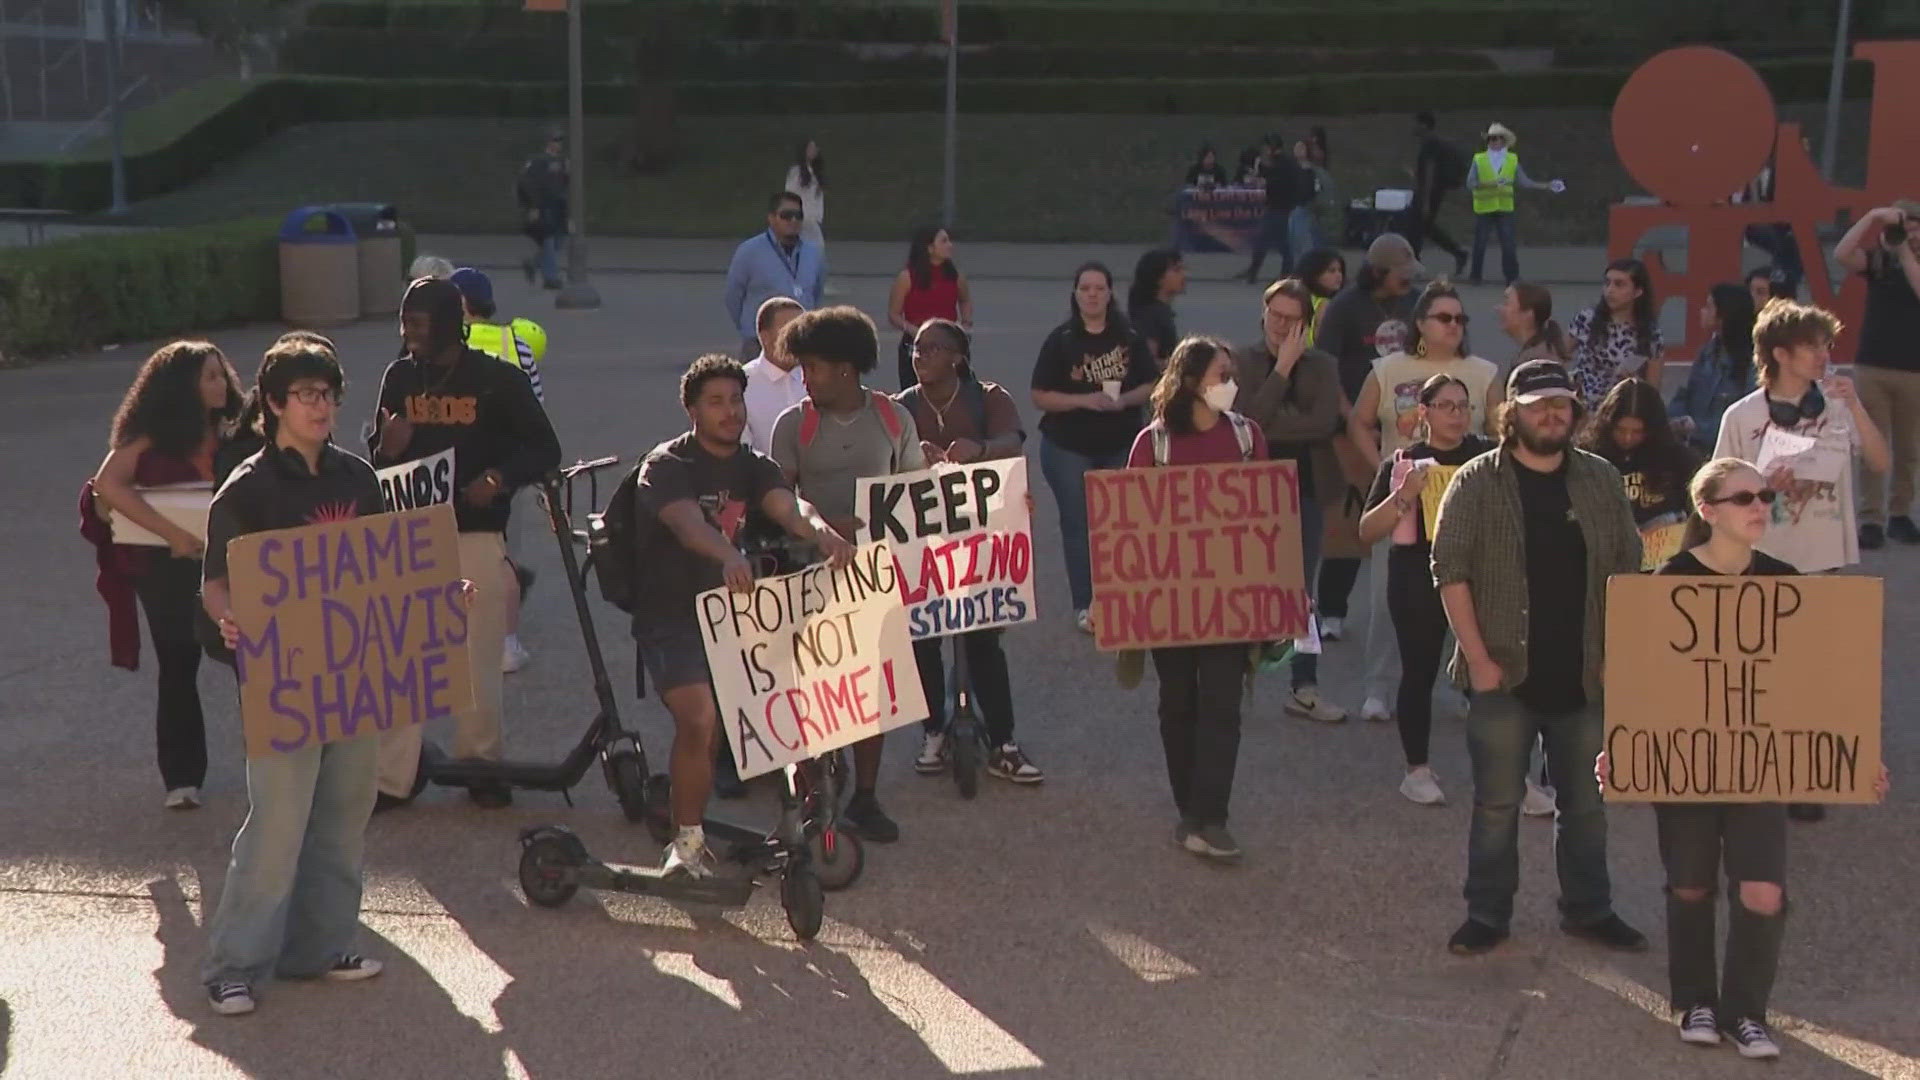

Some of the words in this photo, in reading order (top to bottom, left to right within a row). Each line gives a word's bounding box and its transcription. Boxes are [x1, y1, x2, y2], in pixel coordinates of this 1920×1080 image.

[869, 468, 1000, 544] KEEP
[1085, 465, 1299, 531] DIVERSITY
[259, 517, 435, 606] SHAME
[892, 531, 1030, 606] LATINO
[1090, 523, 1281, 584] EQUITY
[321, 580, 468, 674] DAVIS
[703, 545, 896, 643] PROTESTING
[909, 587, 1027, 637] STUDIES
[1096, 584, 1309, 647] INCLUSION
[1669, 581, 1801, 654] STOP
[741, 642, 776, 696] IS
[792, 609, 861, 676] NOT
[269, 653, 451, 753] SHAME
[1691, 657, 1771, 727] THE
[738, 707, 774, 770] A
[1607, 724, 1859, 796] CONSOLIDATION
